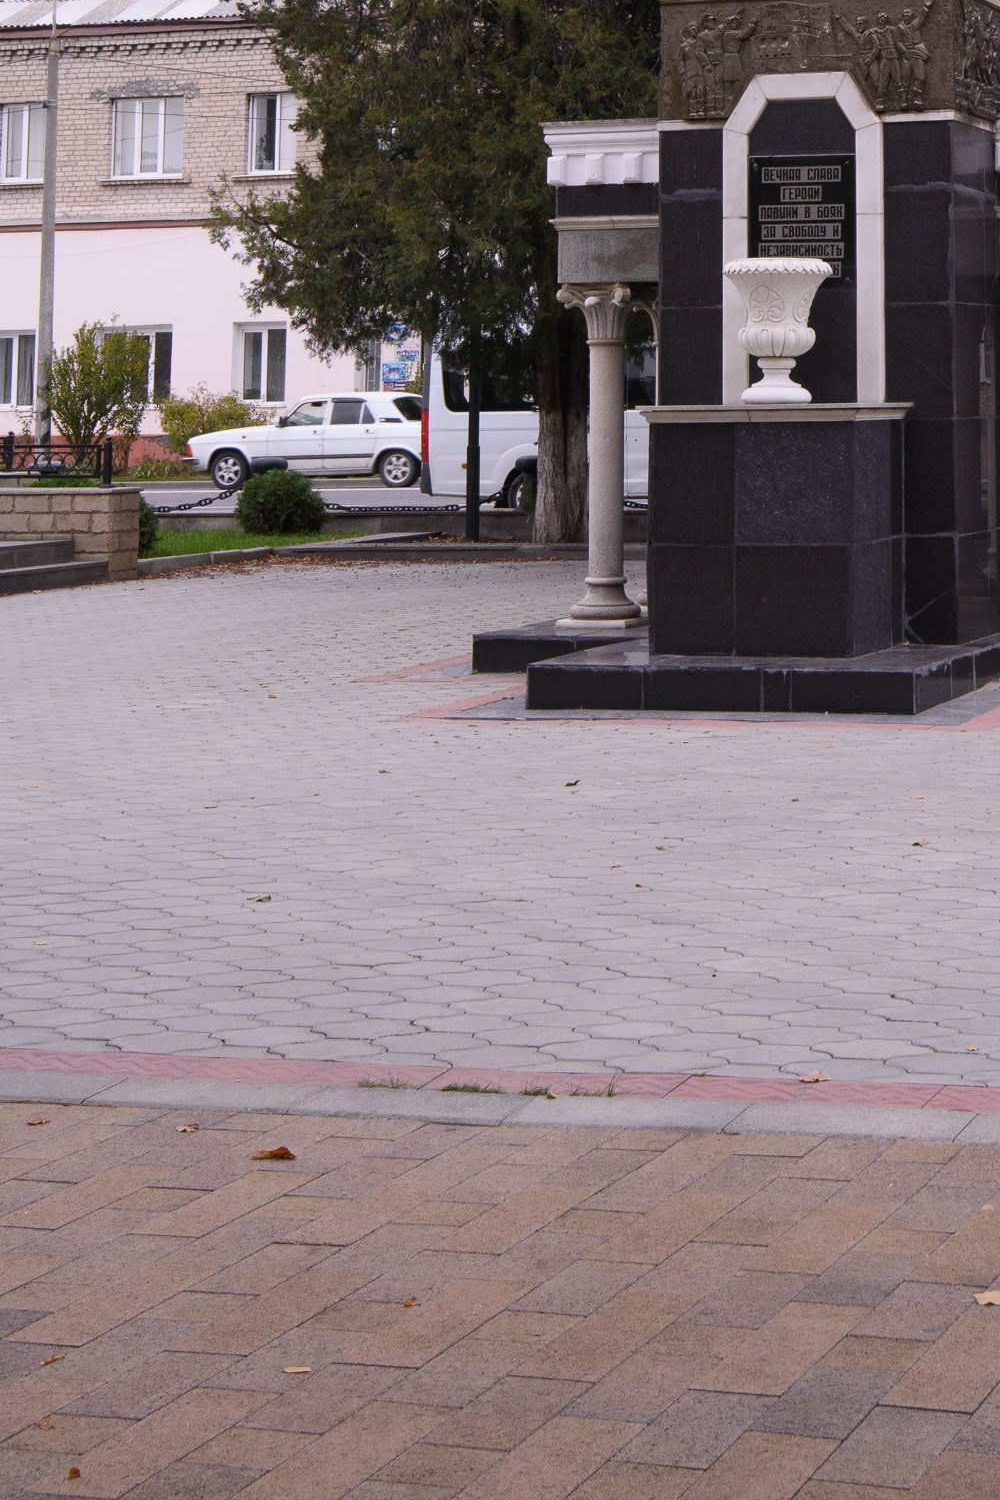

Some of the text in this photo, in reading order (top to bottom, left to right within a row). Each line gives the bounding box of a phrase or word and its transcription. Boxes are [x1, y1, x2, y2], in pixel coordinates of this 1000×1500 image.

[763, 167, 839, 181] ВЕЧНАЯ СЛАВА
[782, 187, 820, 200] ГЕРОЯМ
[760, 205, 843, 220] ПАВШИМ В БОЯХ
[763, 225, 839, 238] ЗА СВОБОДУ И
[760, 244, 843, 257] НЕЗАВИСИМОСТЬ
